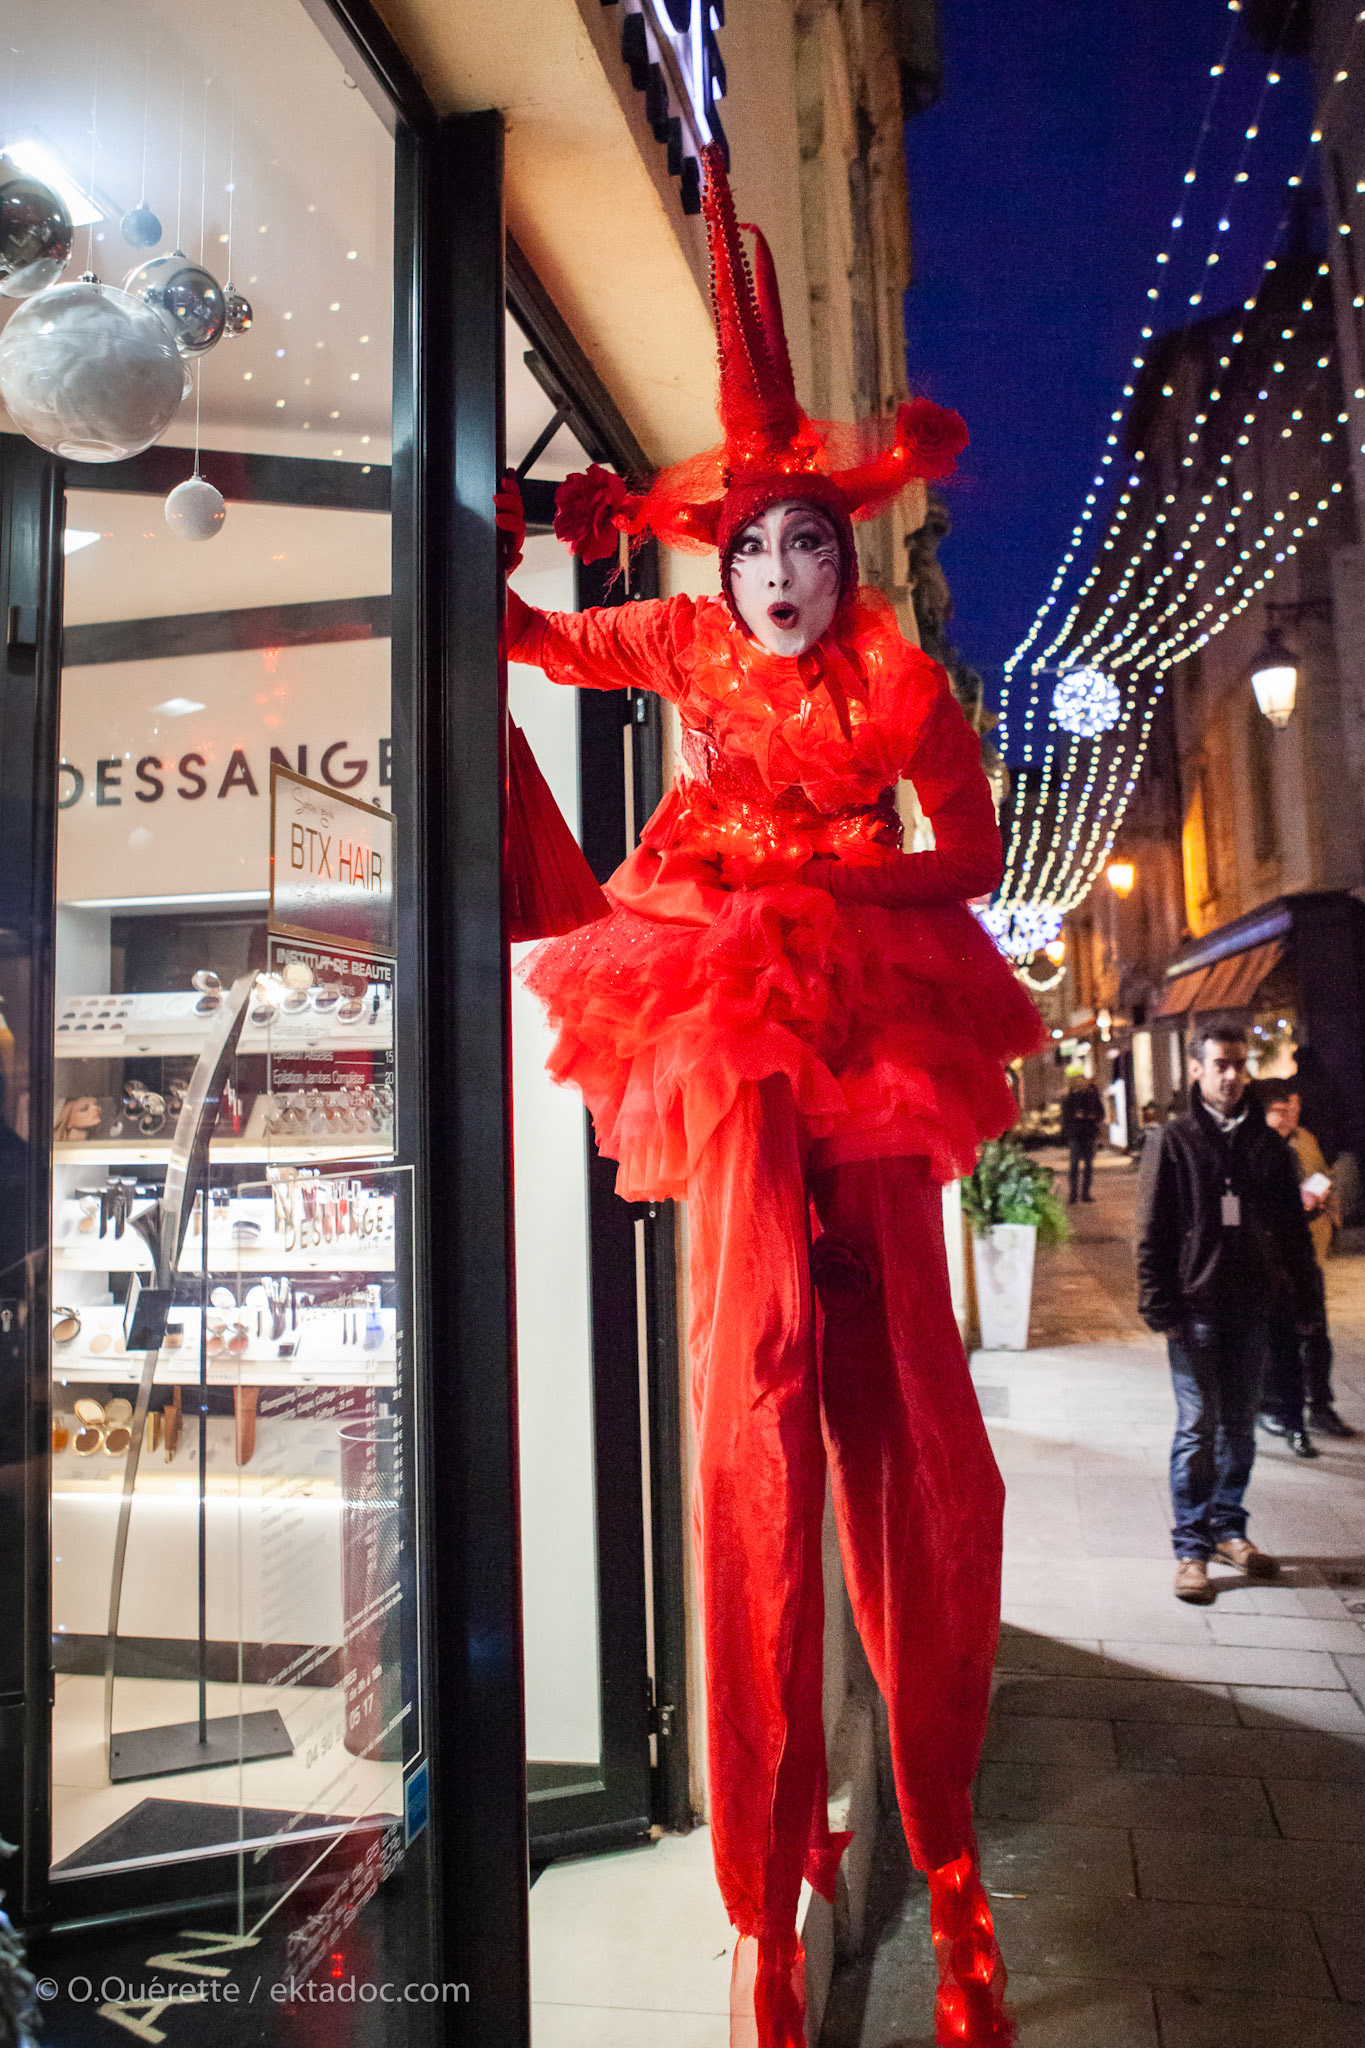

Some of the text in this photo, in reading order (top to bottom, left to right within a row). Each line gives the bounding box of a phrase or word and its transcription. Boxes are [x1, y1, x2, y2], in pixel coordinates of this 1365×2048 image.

[290, 822, 332, 879] BTX
[339, 839, 382, 894] HAIR
[276, 947, 392, 982] INSTITUT DE BEAUTE
[385, 1050, 394, 1064] 15
[385, 1071, 394, 1085] 20
[363, 1693, 374, 1717] 17
[365, 1838, 380, 1866] 25
[381, 1823, 398, 1848] ans
